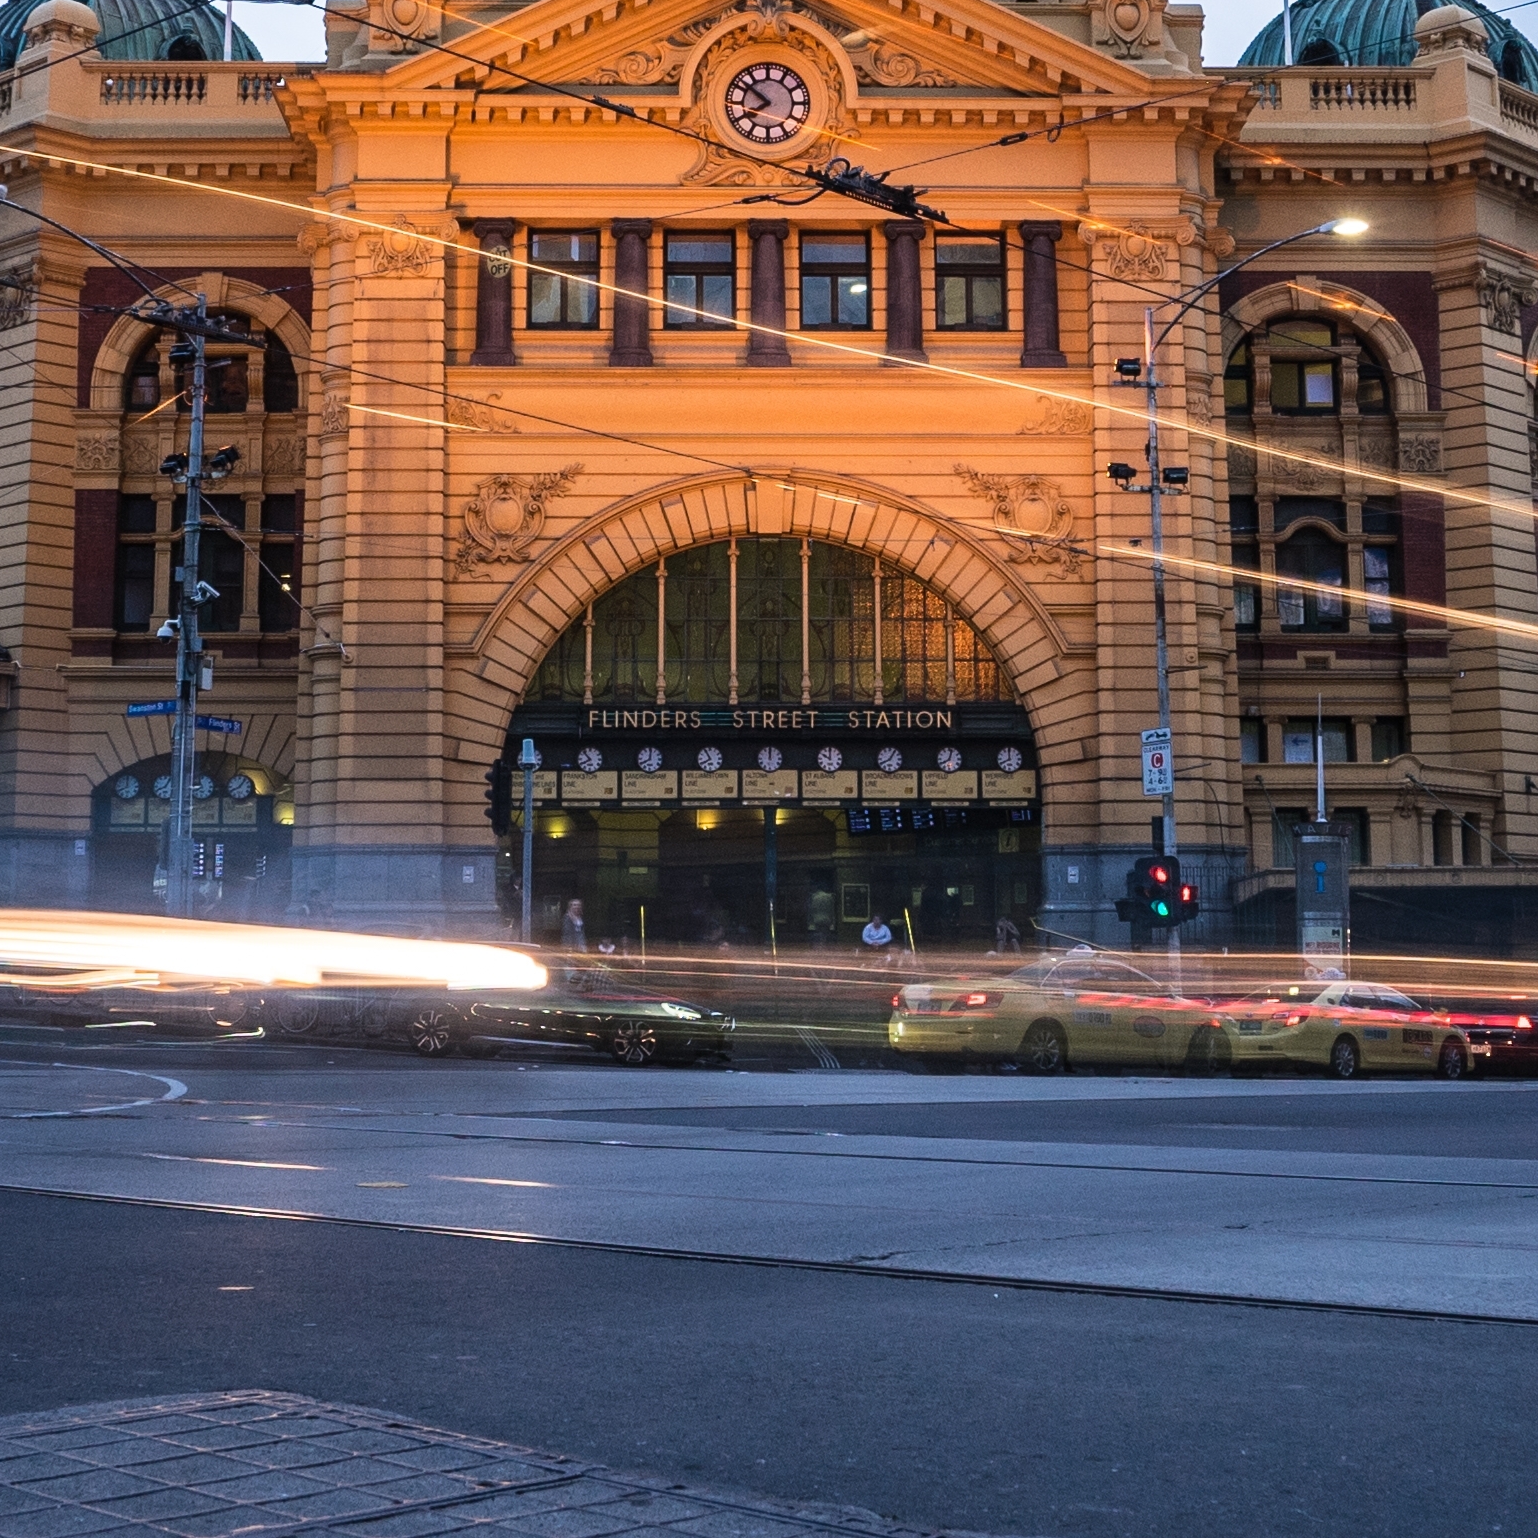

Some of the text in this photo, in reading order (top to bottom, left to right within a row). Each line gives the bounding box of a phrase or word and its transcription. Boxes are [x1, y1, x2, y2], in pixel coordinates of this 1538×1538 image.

[490, 263, 509, 275] OFF
[208, 718, 232, 729] Flinders
[589, 710, 952, 729] FLINDERS STREET STATION
[1153, 754, 1161, 767] C
